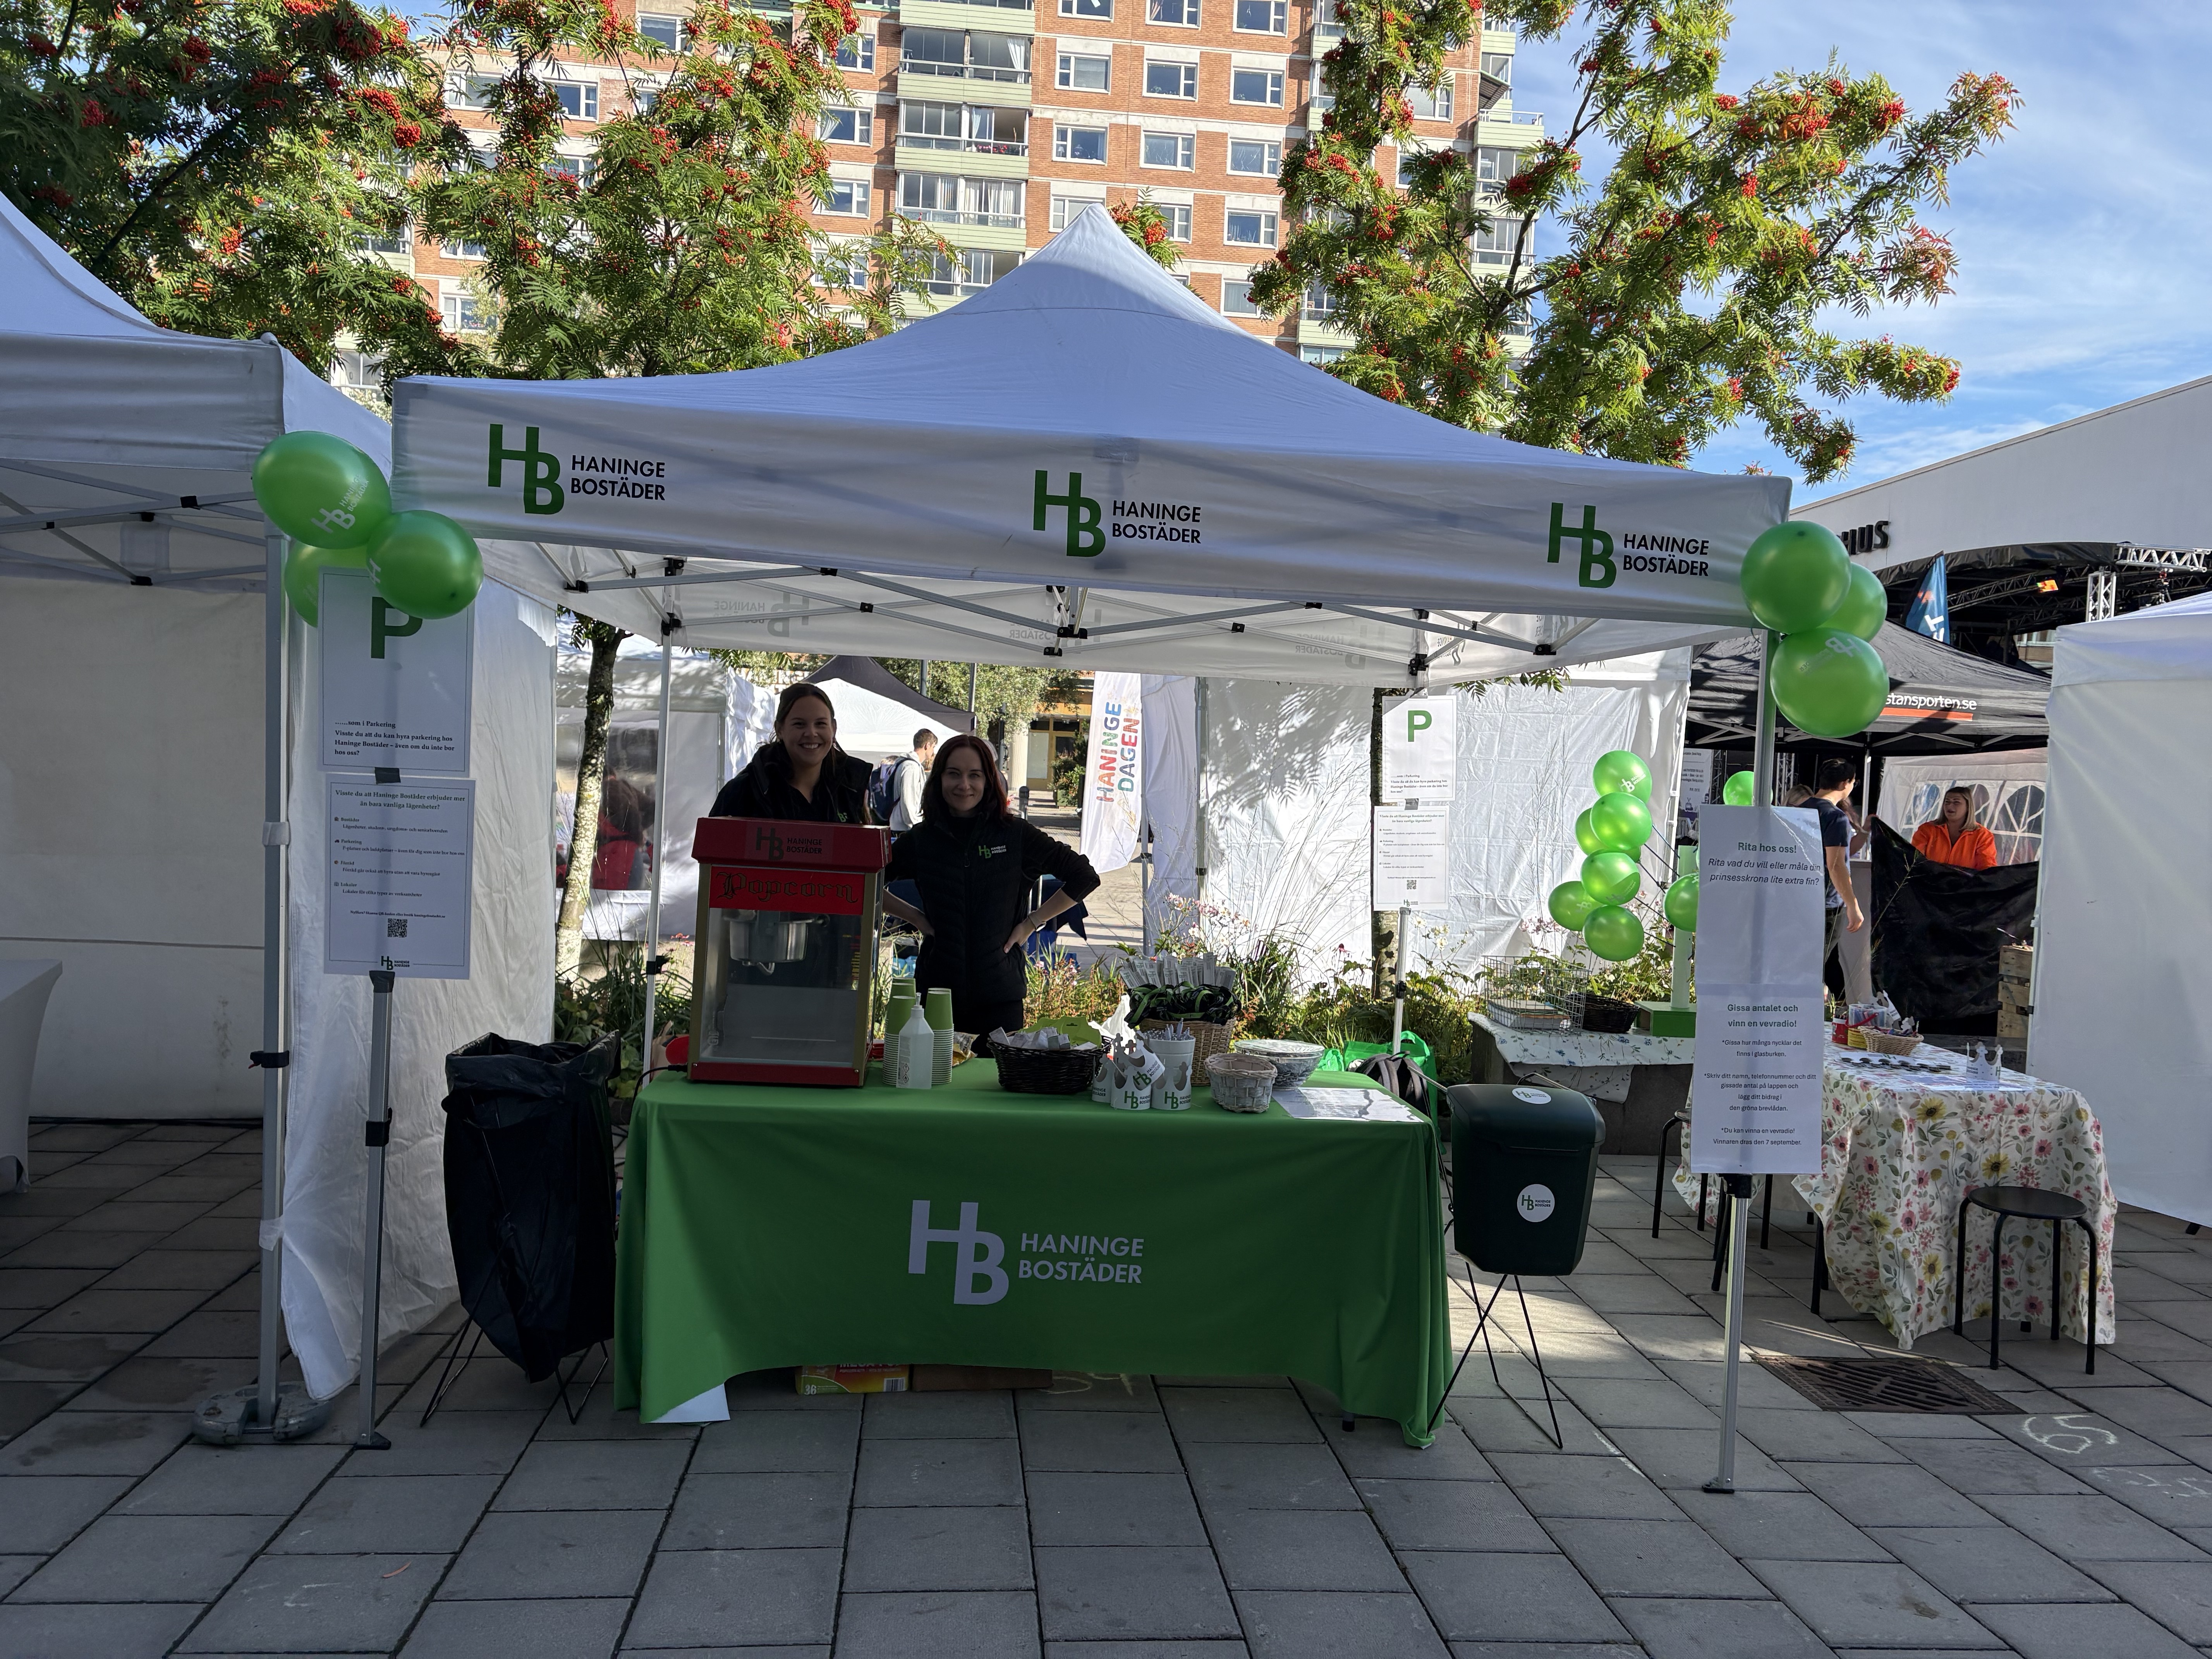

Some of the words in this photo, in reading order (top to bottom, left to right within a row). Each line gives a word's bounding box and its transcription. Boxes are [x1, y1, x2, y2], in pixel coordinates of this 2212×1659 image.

[488, 424, 565, 515] HB
[572, 455, 665, 478] HANINGE
[571, 476, 665, 501] BOSTÄDER
[1033, 469, 1106, 558] HB
[1112, 500, 1201, 523] HANINGE
[1112, 521, 1201, 544] BOSTÄDER
[1624, 533, 1709, 555] HANINGE
[1836, 520, 1889, 556] HUS
[1547, 502, 1617, 588] HB
[1623, 554, 1709, 577] BOSTÄDER
[371, 596, 423, 659] P
[366, 720, 396, 729] Parkering
[1408, 710, 1432, 742] P
[335, 739, 361, 748] Haninge
[411, 734, 441, 742] parkering
[1096, 702, 1122, 802] HANINGE
[1117, 718, 1140, 792] DAGEN
[373, 791, 398, 800] Haninge
[406, 802, 440, 810] lägenheter?
[756, 827, 784, 861] HB
[786, 845, 822, 854] BOSTÄDER
[787, 837, 823, 845] HANINGE
[1738, 842, 1757, 851] Rita
[1759, 843, 1776, 852] hos
[1778, 845, 1796, 854] oss!
[1708, 858, 1725, 866] Rita
[1743, 860, 1755, 868] du
[1757, 860, 1768, 869] vill
[1769, 861, 1788, 869] eller
[1789, 862, 1808, 871] måla
[1809, 863, 1820, 871] din
[715, 871, 859, 903] Popcorn
[1709, 873, 1769, 883] prinsesskrona
[1770, 875, 1783, 884] lite
[1805, 877, 1819, 885] fin?
[381, 955, 393, 970] HB
[1727, 1003, 1750, 1012] Gissa
[1752, 1004, 1781, 1012] antalet
[1728, 1019, 1746, 1027] vinn
[1759, 1019, 1797, 1027] vevradio!
[1124, 1091, 1139, 1109] HB
[1164, 1091, 1179, 1109] HB
[1521, 1195, 1534, 1211] HB
[908, 1200, 1009, 1305] HB
[1020, 1233, 1144, 1257] HANINGE
[1018, 1257, 1142, 1284] BOSTÄDER
